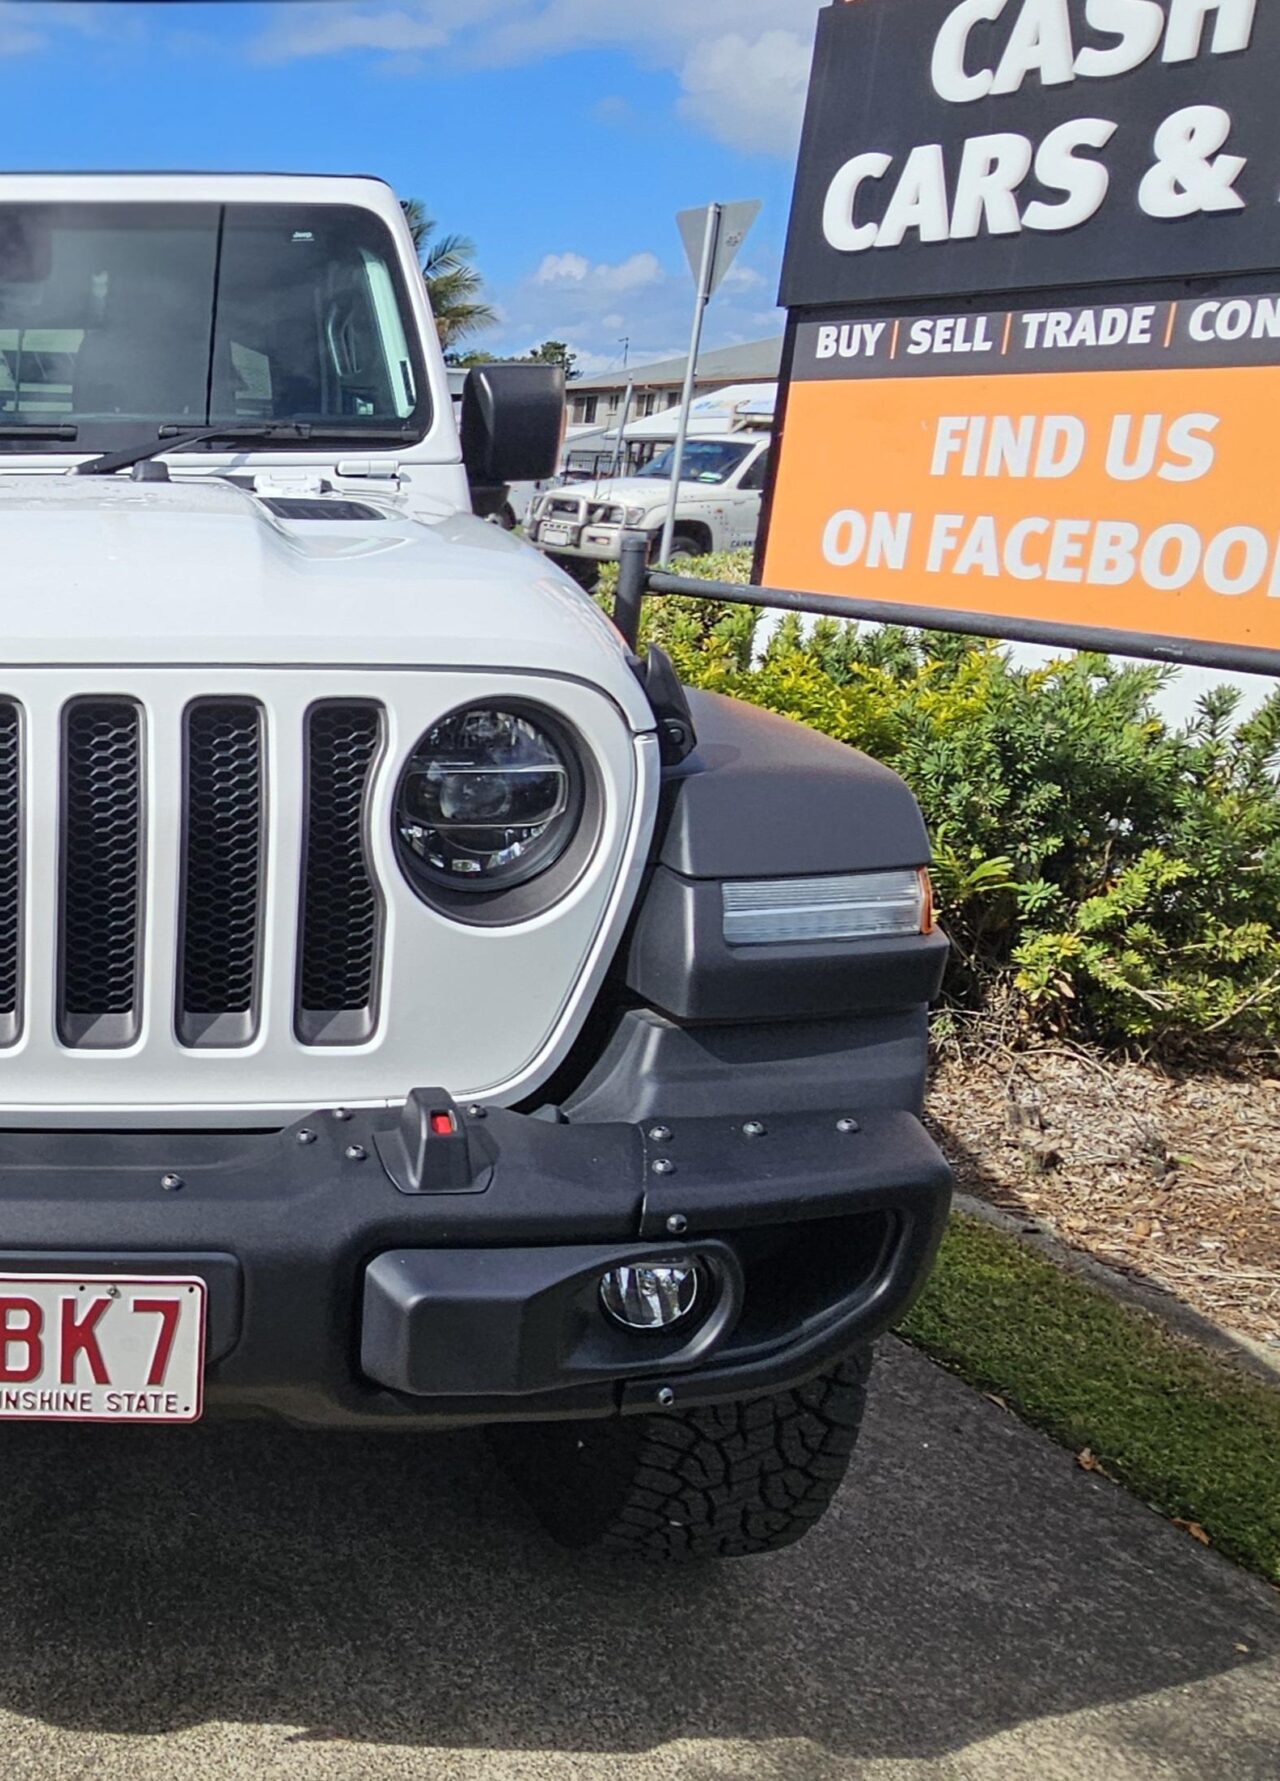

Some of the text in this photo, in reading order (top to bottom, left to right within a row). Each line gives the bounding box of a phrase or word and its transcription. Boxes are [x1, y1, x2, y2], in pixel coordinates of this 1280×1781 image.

[931, 0, 1258, 102] CASH
[823, 105, 1247, 251] CARS &
[815, 297, 1280, 359] BUY SELL TRADE CON
[929, 413, 1221, 482] FIND US
[822, 509, 1280, 598] ON FACEBOO
[106, 1393, 179, 1414] STATE
